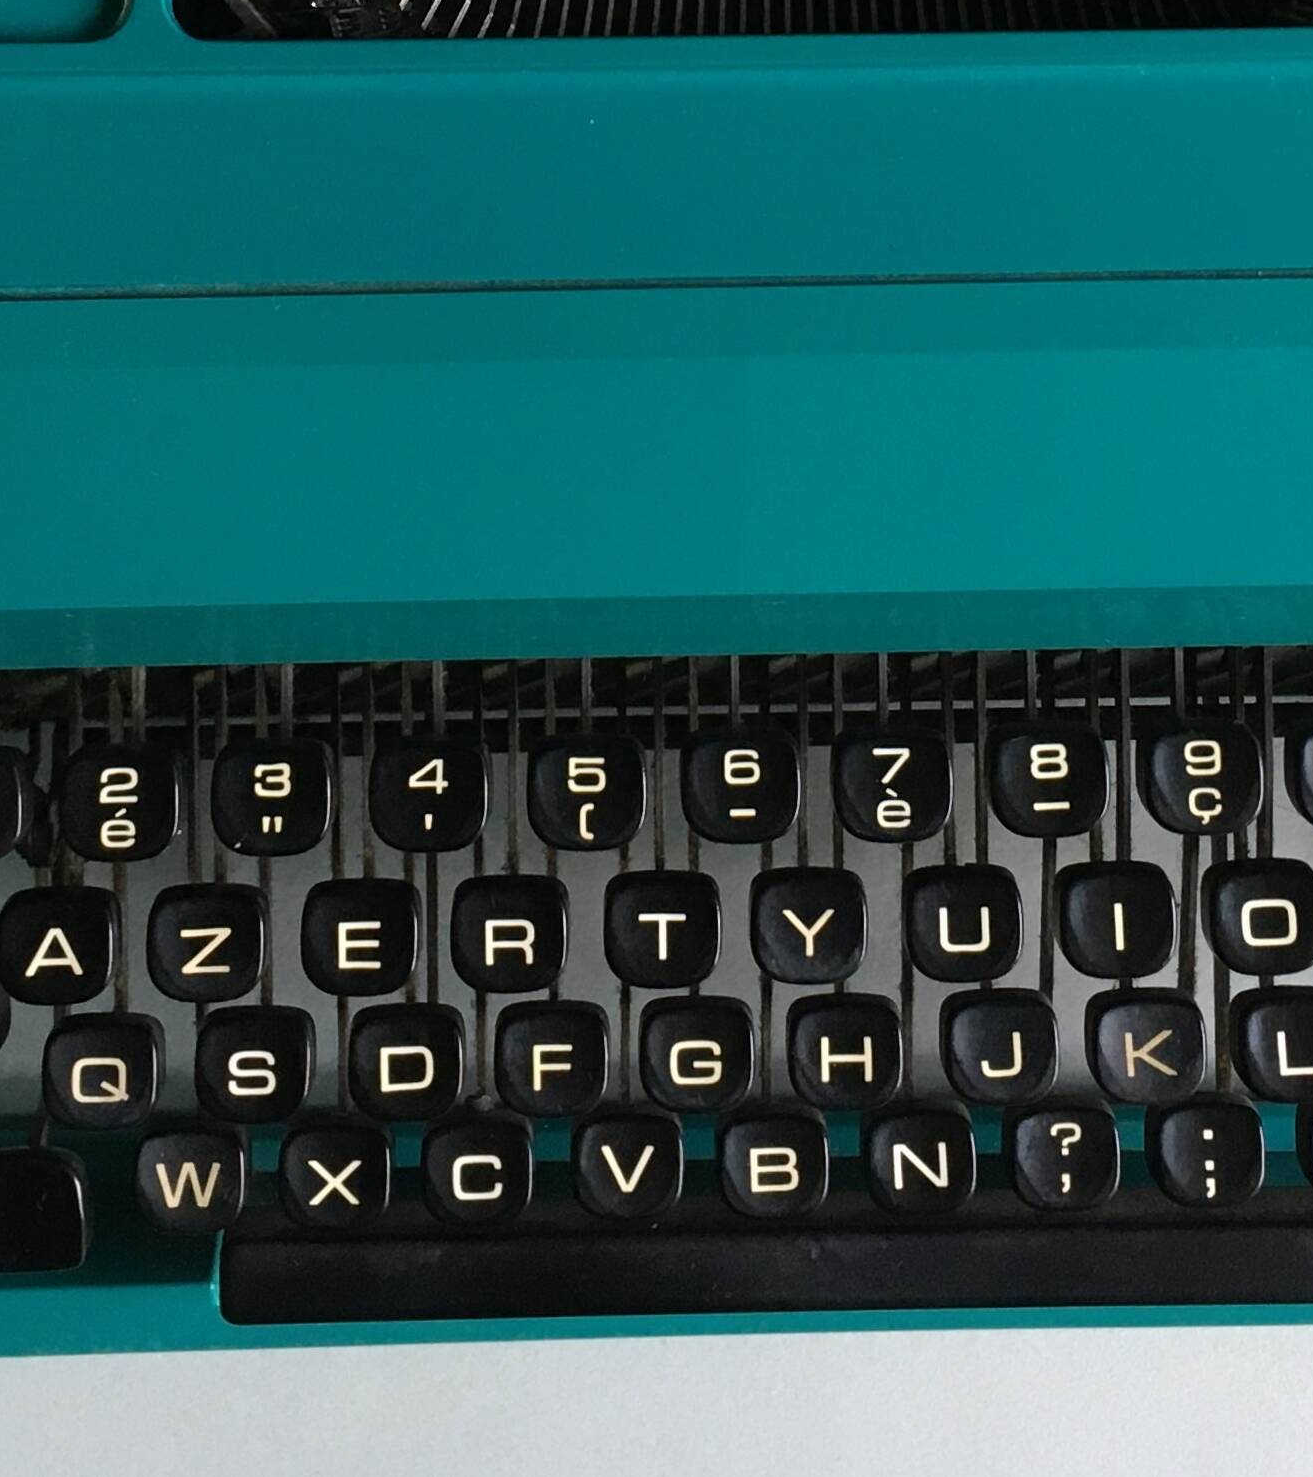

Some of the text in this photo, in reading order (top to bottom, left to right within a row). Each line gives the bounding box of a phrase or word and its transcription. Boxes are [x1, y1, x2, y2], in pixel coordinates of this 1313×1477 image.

[99, 767, 138, 804] 2
[254, 762, 291, 798] 3
[408, 758, 449, 795] 4
[567, 757, 606, 793] 5
[724, 749, 761, 785] 6
[872, 747, 910, 784] 7
[1030, 743, 1069, 780] 8
[1184, 740, 1222, 776] 9
[100, 808, 136, 848] é
[876, 788, 911, 829] è
[1188, 787, 1223, 825] ç
[25, 927, 83, 977] A
[180, 927, 232, 975] Z
[337, 921, 381, 969] E
[484, 919, 535, 966] R
[638, 913, 687, 961] T
[782, 909, 835, 957] Y
[938, 906, 991, 953] U
[1113, 902, 1125, 951] I
[1241, 898, 1298, 947] O
[71, 1057, 129, 1103] Q
[228, 1050, 276, 1096] S
[379, 1045, 434, 1093] D
[532, 1044, 573, 1092] F
[669, 1040, 722, 1085] G
[820, 1036, 873, 1083] H
[980, 1031, 1022, 1078] J
[1124, 1030, 1177, 1078] K
[155, 1162, 221, 1209] W
[307, 1160, 362, 1206] X
[452, 1154, 503, 1201] C
[601, 1145, 654, 1193] V
[749, 1147, 799, 1193] B
[892, 1141, 949, 1190] N
[1050, 1122, 1082, 1156] ?
[1204, 1160, 1216, 1199] ;
